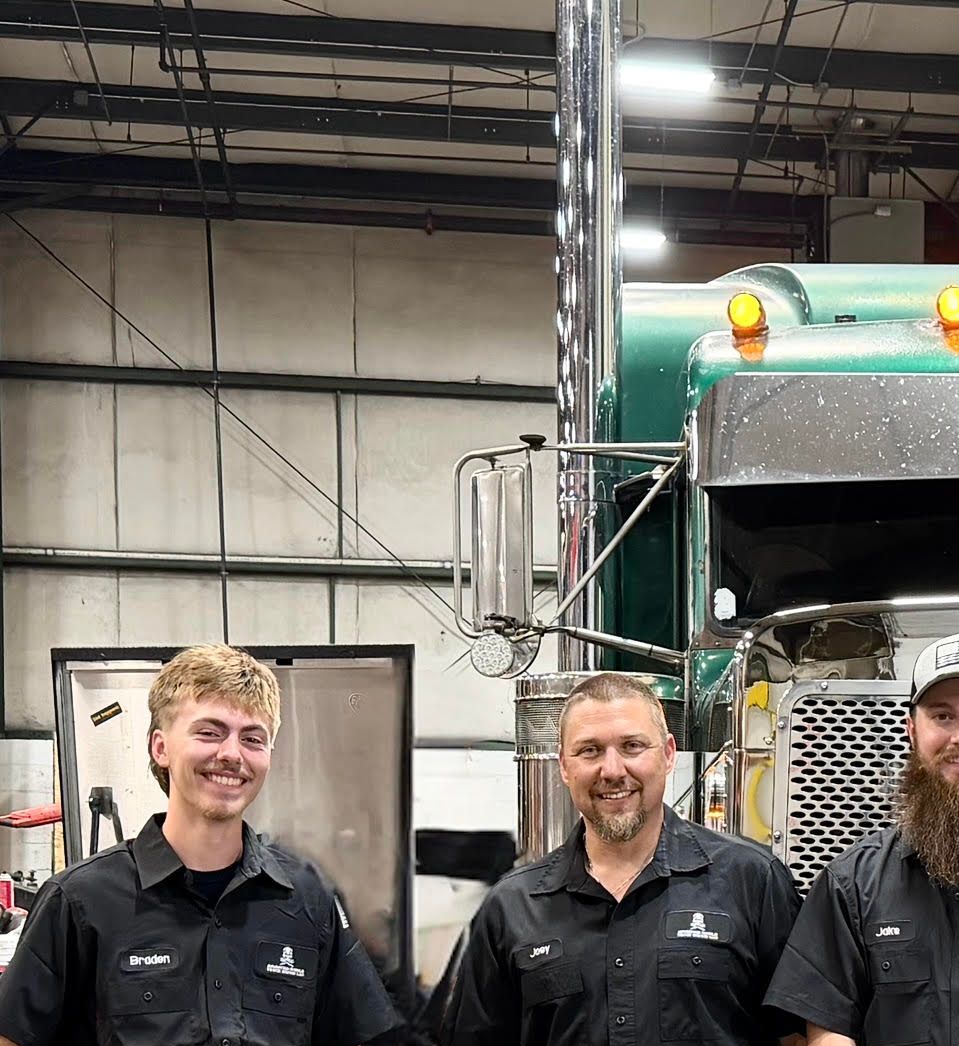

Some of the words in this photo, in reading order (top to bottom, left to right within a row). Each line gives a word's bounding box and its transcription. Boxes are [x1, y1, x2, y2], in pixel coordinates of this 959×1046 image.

[875, 926, 900, 937] Jake
[529, 944, 551, 958] Joey
[129, 954, 171, 966] Braden
